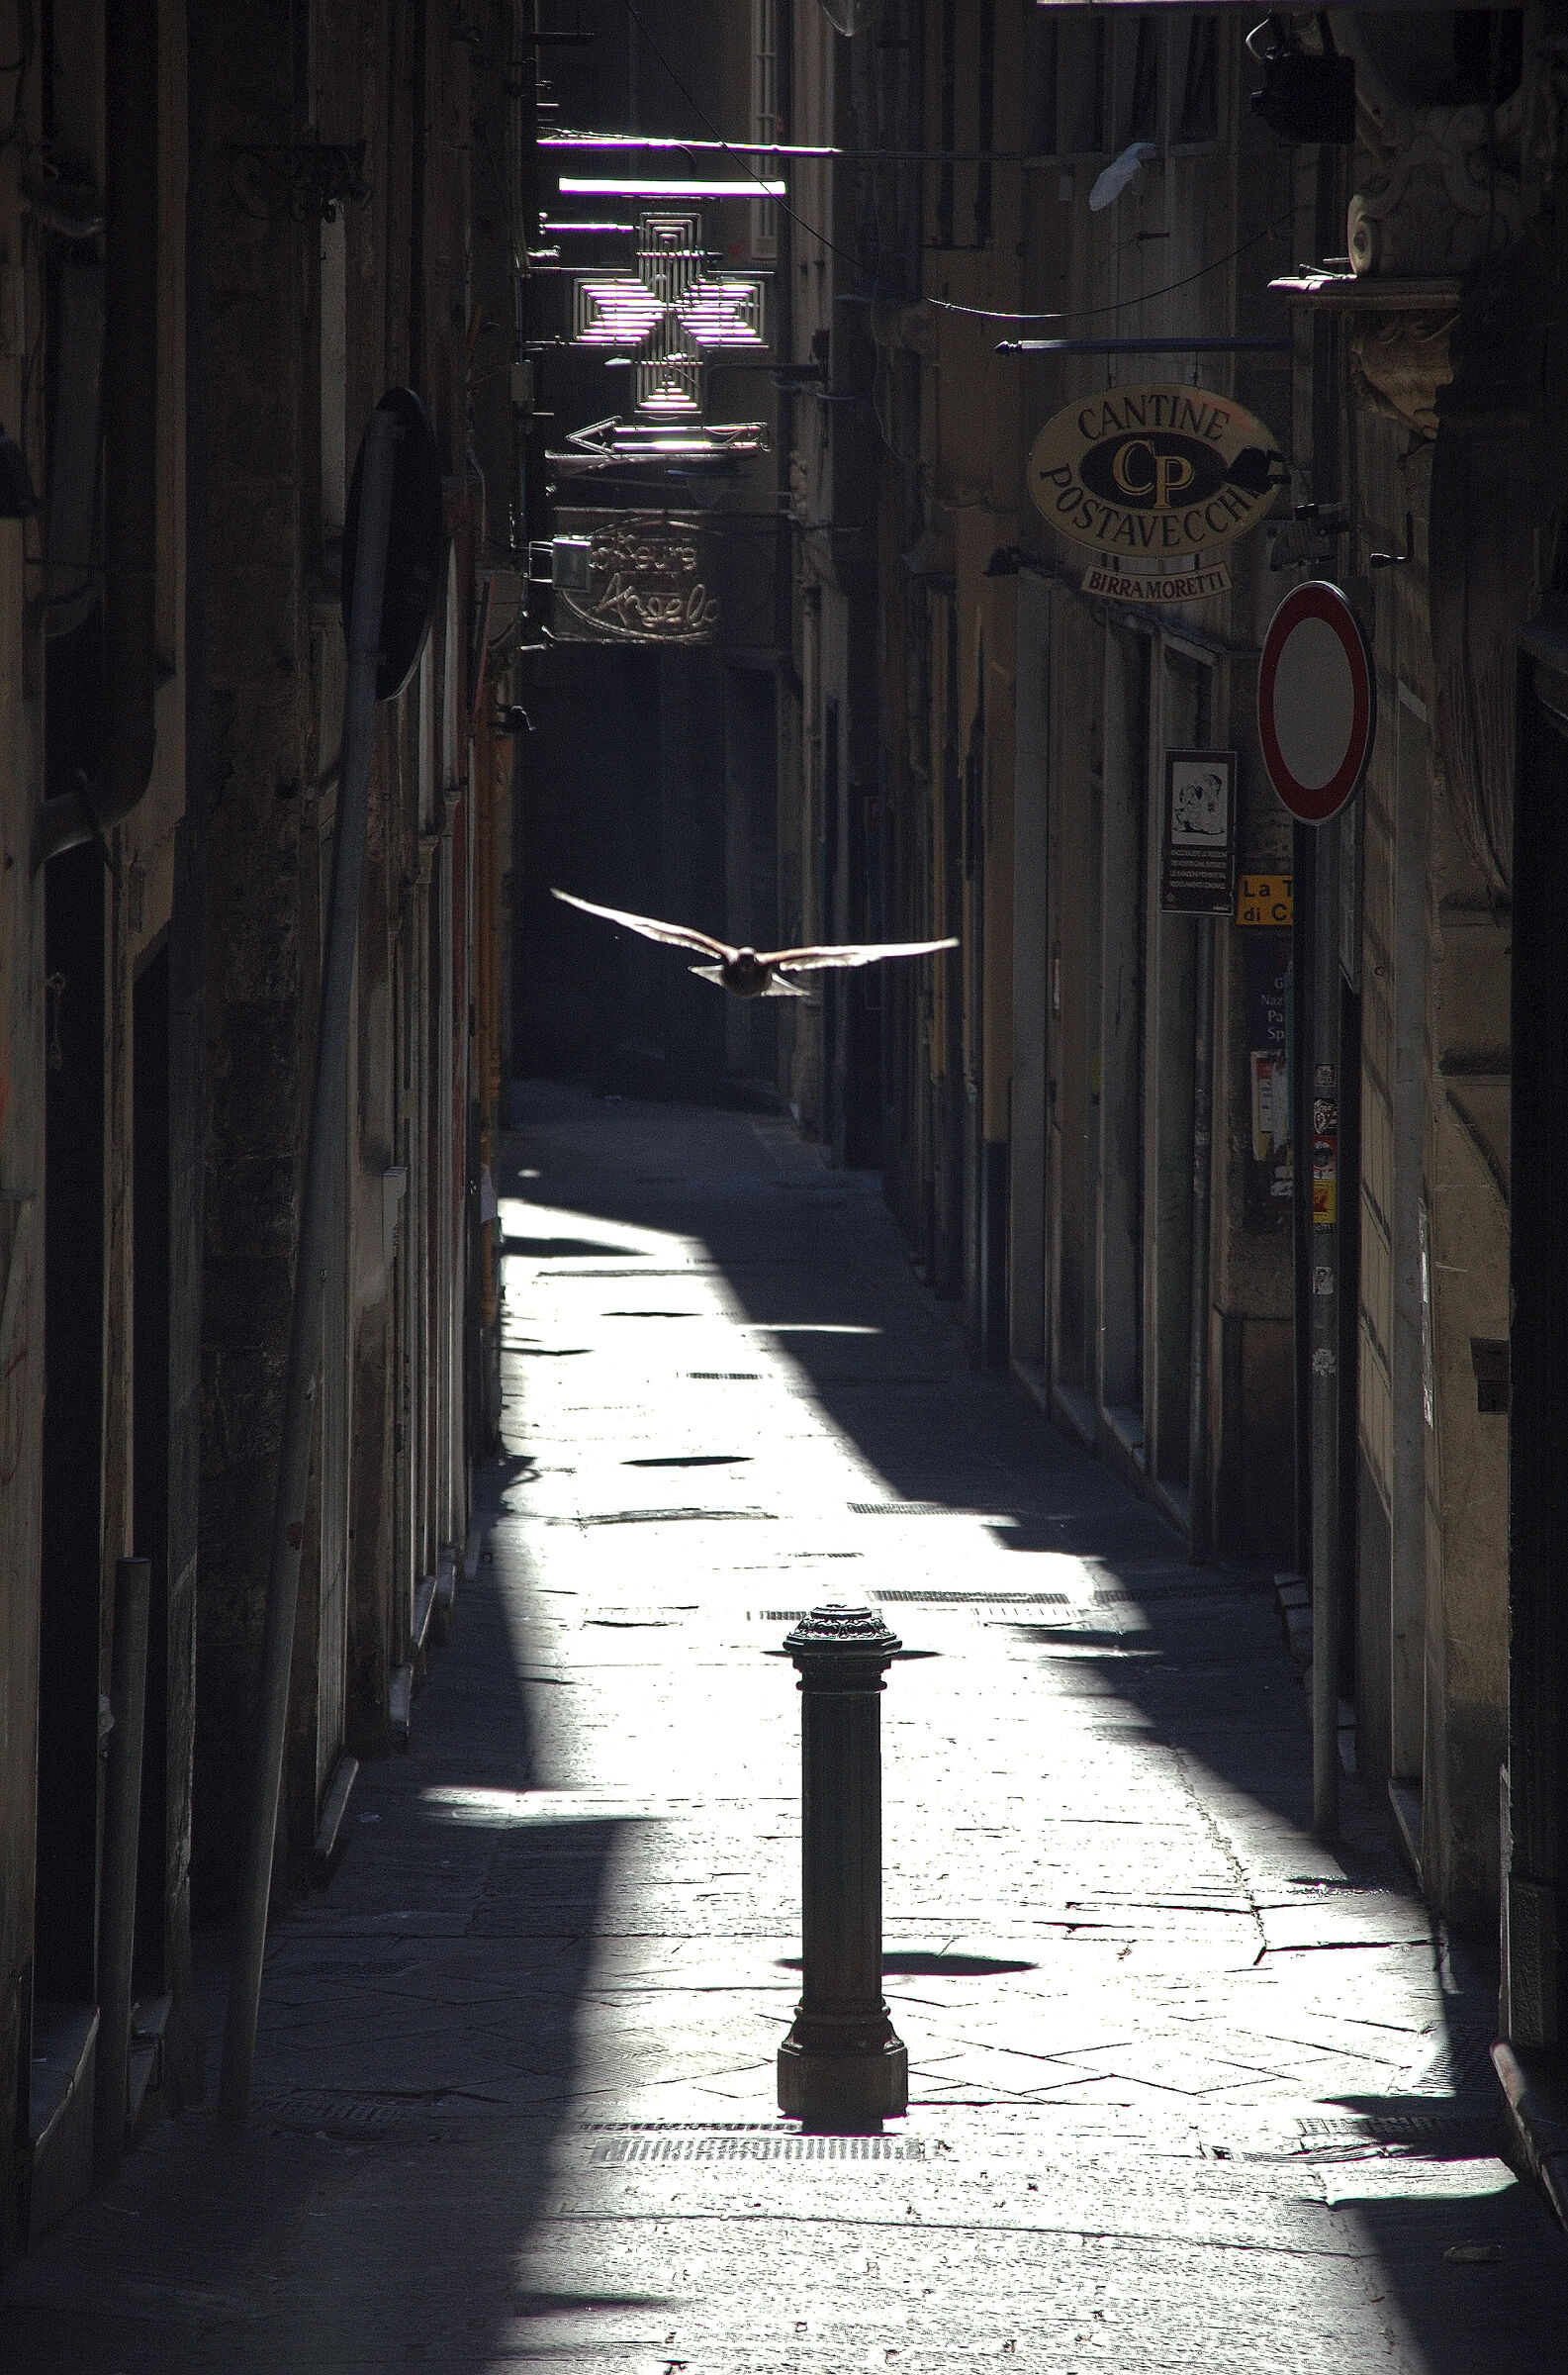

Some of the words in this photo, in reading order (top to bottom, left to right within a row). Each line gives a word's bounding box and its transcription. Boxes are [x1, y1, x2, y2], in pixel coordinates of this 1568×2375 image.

[1077, 394, 1231, 441] CANTINE
[1112, 439, 1196, 510] CP
[1089, 571, 1145, 598] BIRRA
[1145, 572, 1226, 600] MORETTI
[1244, 880, 1271, 898] La
[1282, 880, 1293, 898] T
[1244, 906, 1260, 921] di
[1272, 902, 1292, 921] C
[1273, 977, 1284, 990] G
[1260, 994, 1284, 1005] Naz
[1267, 1009, 1284, 1022] Pa
[1267, 1026, 1285, 1042] Sp
